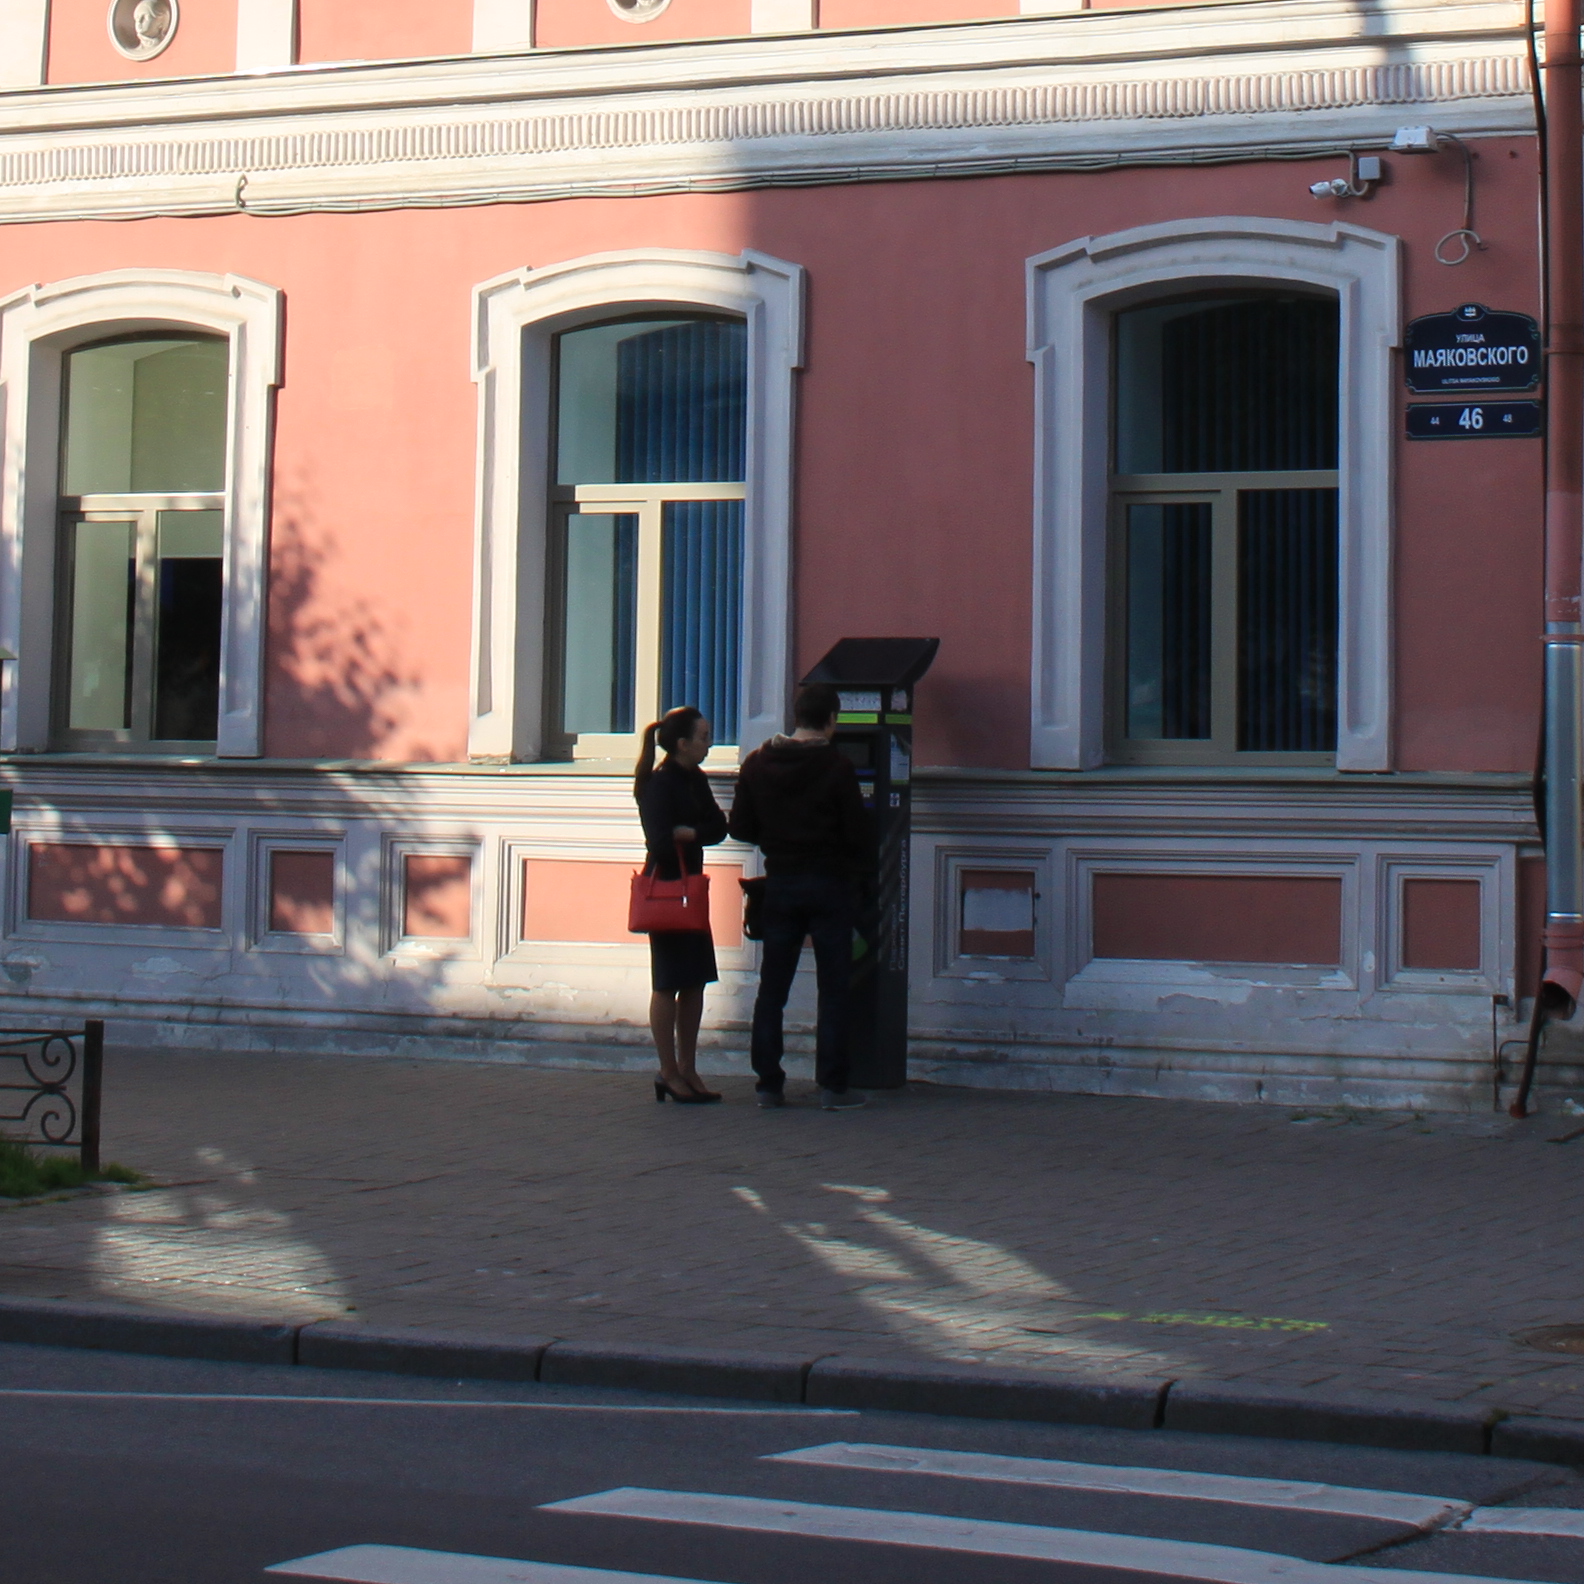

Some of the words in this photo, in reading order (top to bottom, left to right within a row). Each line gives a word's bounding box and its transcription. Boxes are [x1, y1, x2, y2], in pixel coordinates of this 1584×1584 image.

[1456, 333, 1485, 343] УЛИЦА
[1414, 346, 1529, 368] МАЯКОВСКОГО
[1430, 416, 1440, 425] 44
[1459, 407, 1484, 429] 46
[898, 839, 907, 970] Санкт-Петербурга
